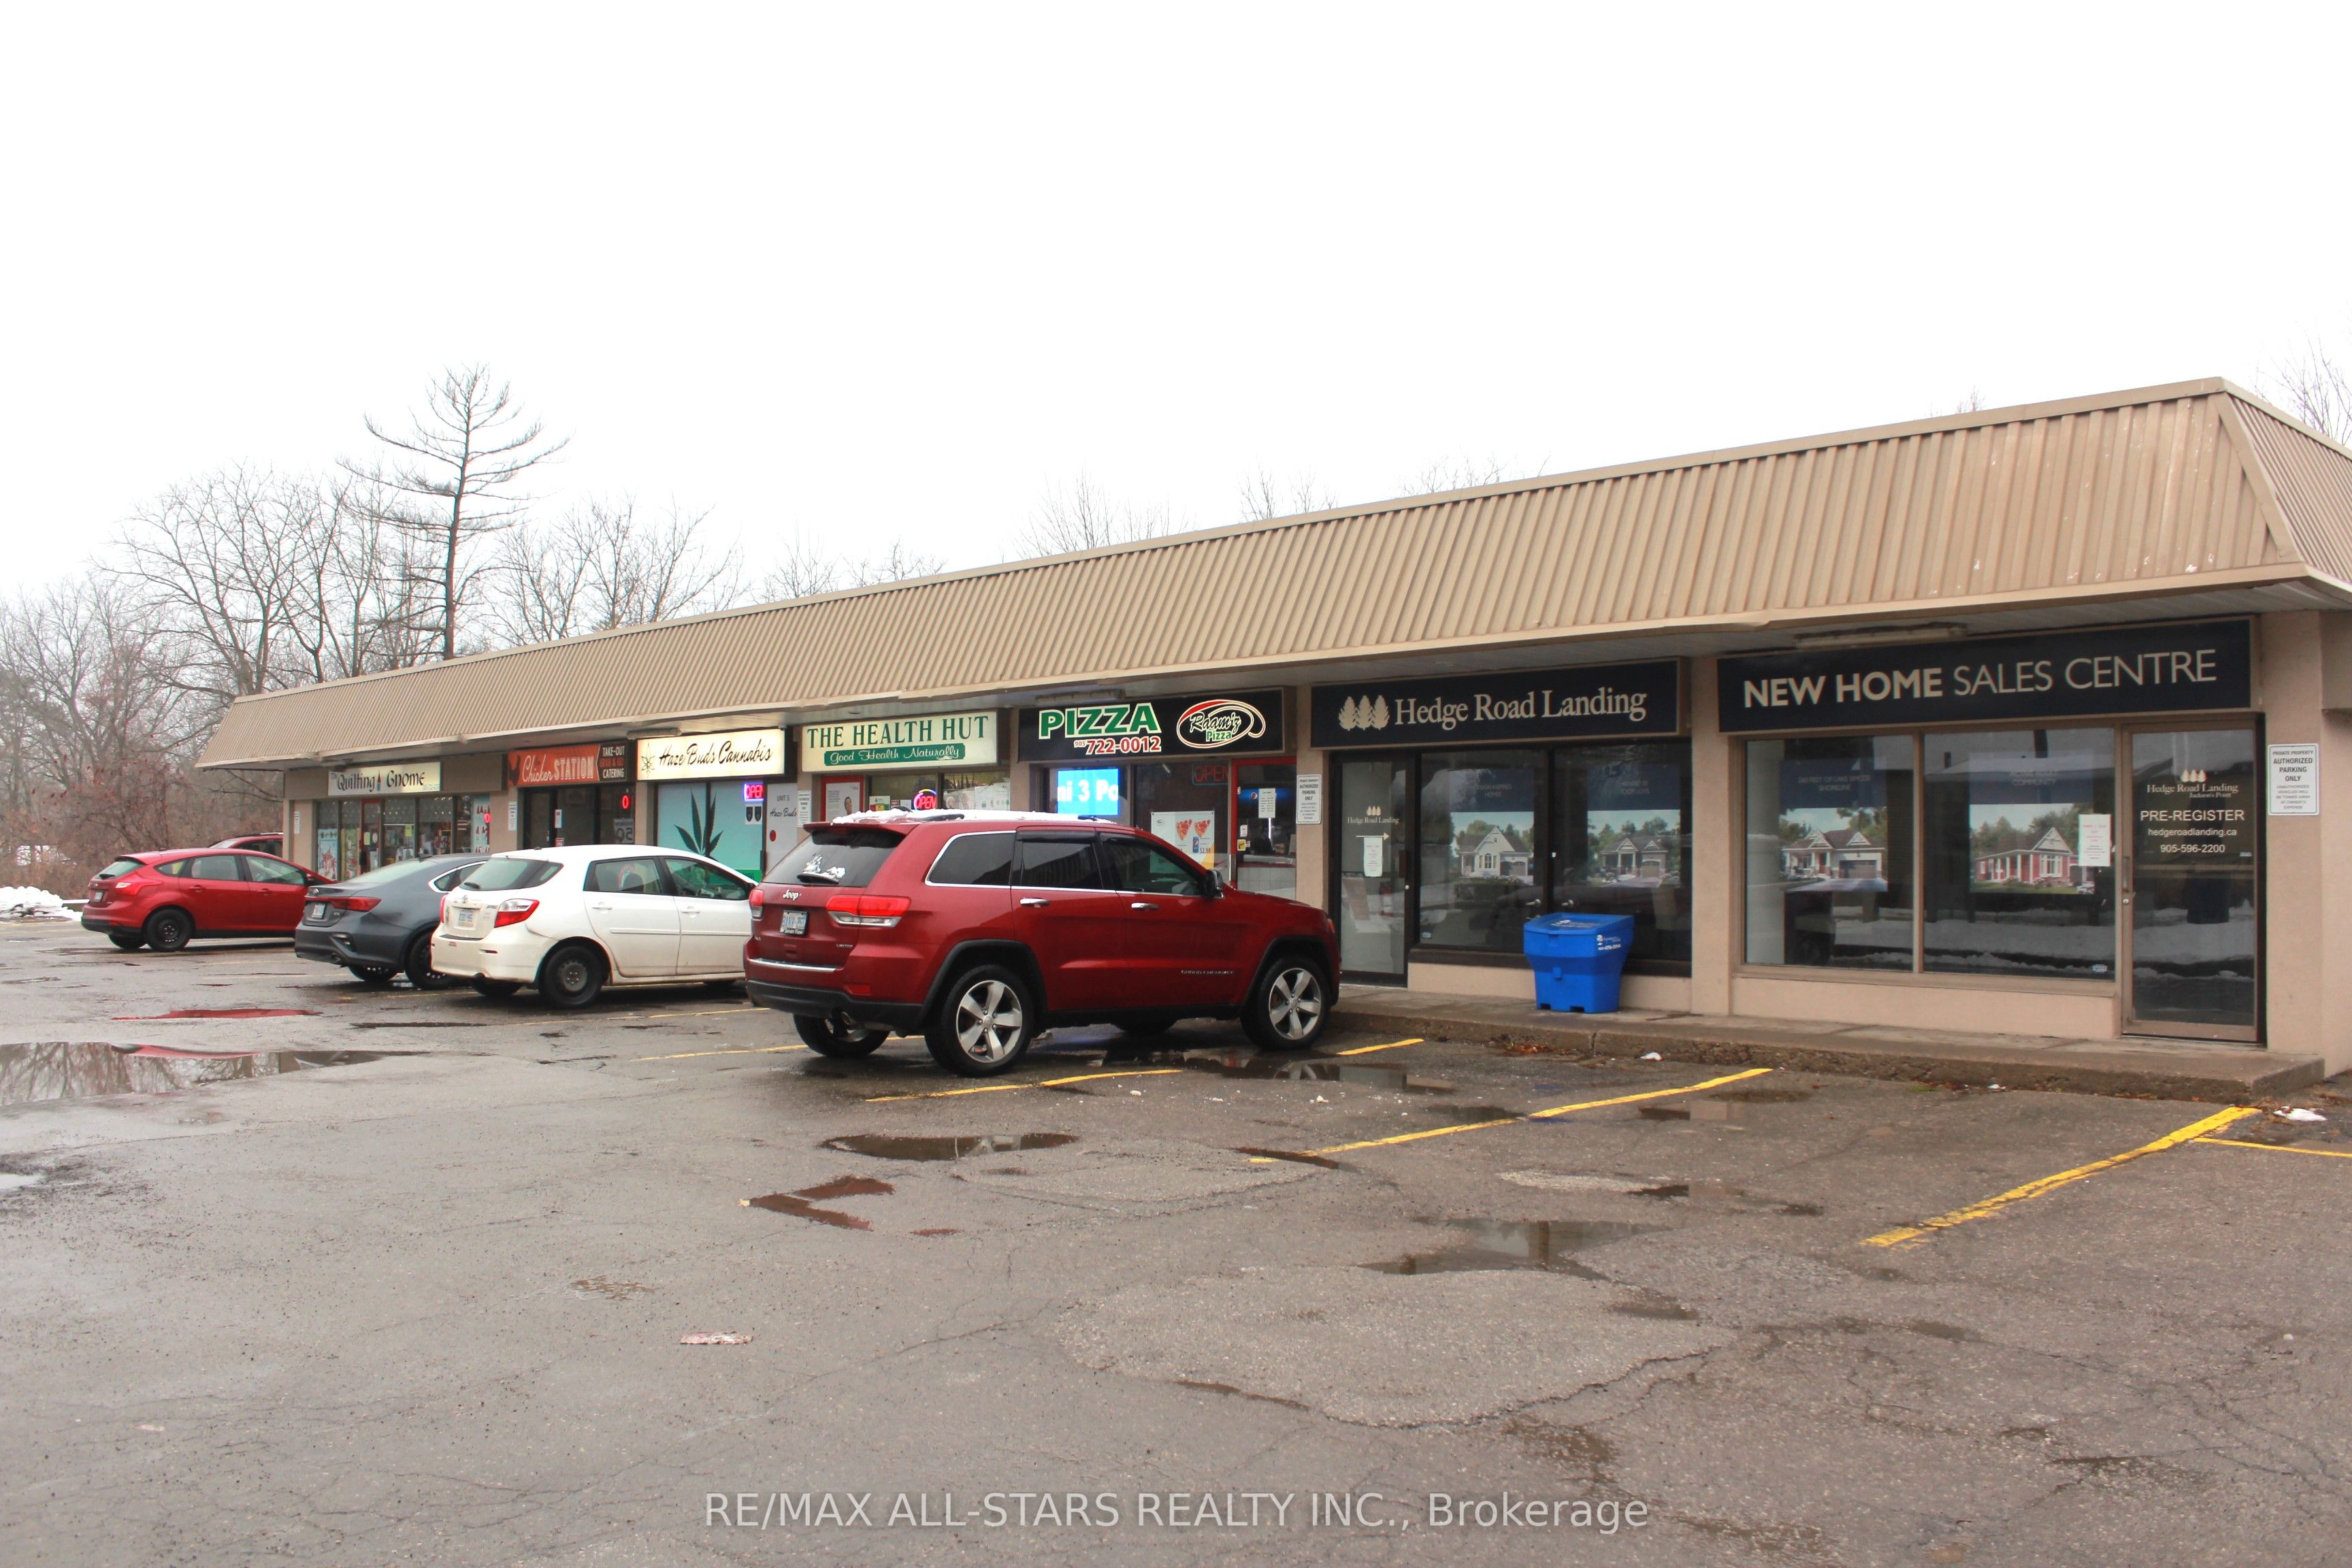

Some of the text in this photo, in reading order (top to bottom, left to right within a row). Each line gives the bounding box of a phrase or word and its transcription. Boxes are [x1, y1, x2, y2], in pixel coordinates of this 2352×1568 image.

[1744, 649, 2217, 708] NEW HOME SALES CENTRE
[1395, 687, 1647, 731] Hedge Road Landing
[1039, 702, 1162, 740] PIZZA
[807, 715, 988, 749] THE HEALTH HUT
[1206, 730, 1232, 742] Pizza
[603, 746, 625, 757] TAKE-OUT
[659, 738, 773, 767] Haze Buds Cannabis
[830, 745, 960, 765] Good Health Naturally
[1075, 736, 1162, 755] 905 722-0012
[522, 754, 594, 783] Chicken STATION
[603, 768, 624, 779] CATERING
[338, 773, 375, 792] Quilting
[387, 770, 425, 788] Gnome
[1077, 779, 1090, 802] 3
[2146, 783, 2238, 794] Hedge Road Landing
[1348, 817, 1363, 825] Hedge
[1379, 817, 1399, 825] Landing
[2140, 810, 2245, 821] PRE-REGISTER
[2148, 828, 2237, 838] hedgeroadlanding.ca
[2160, 845, 2225, 853] 905-596-2200
[783, 889, 799, 900] Jeep
